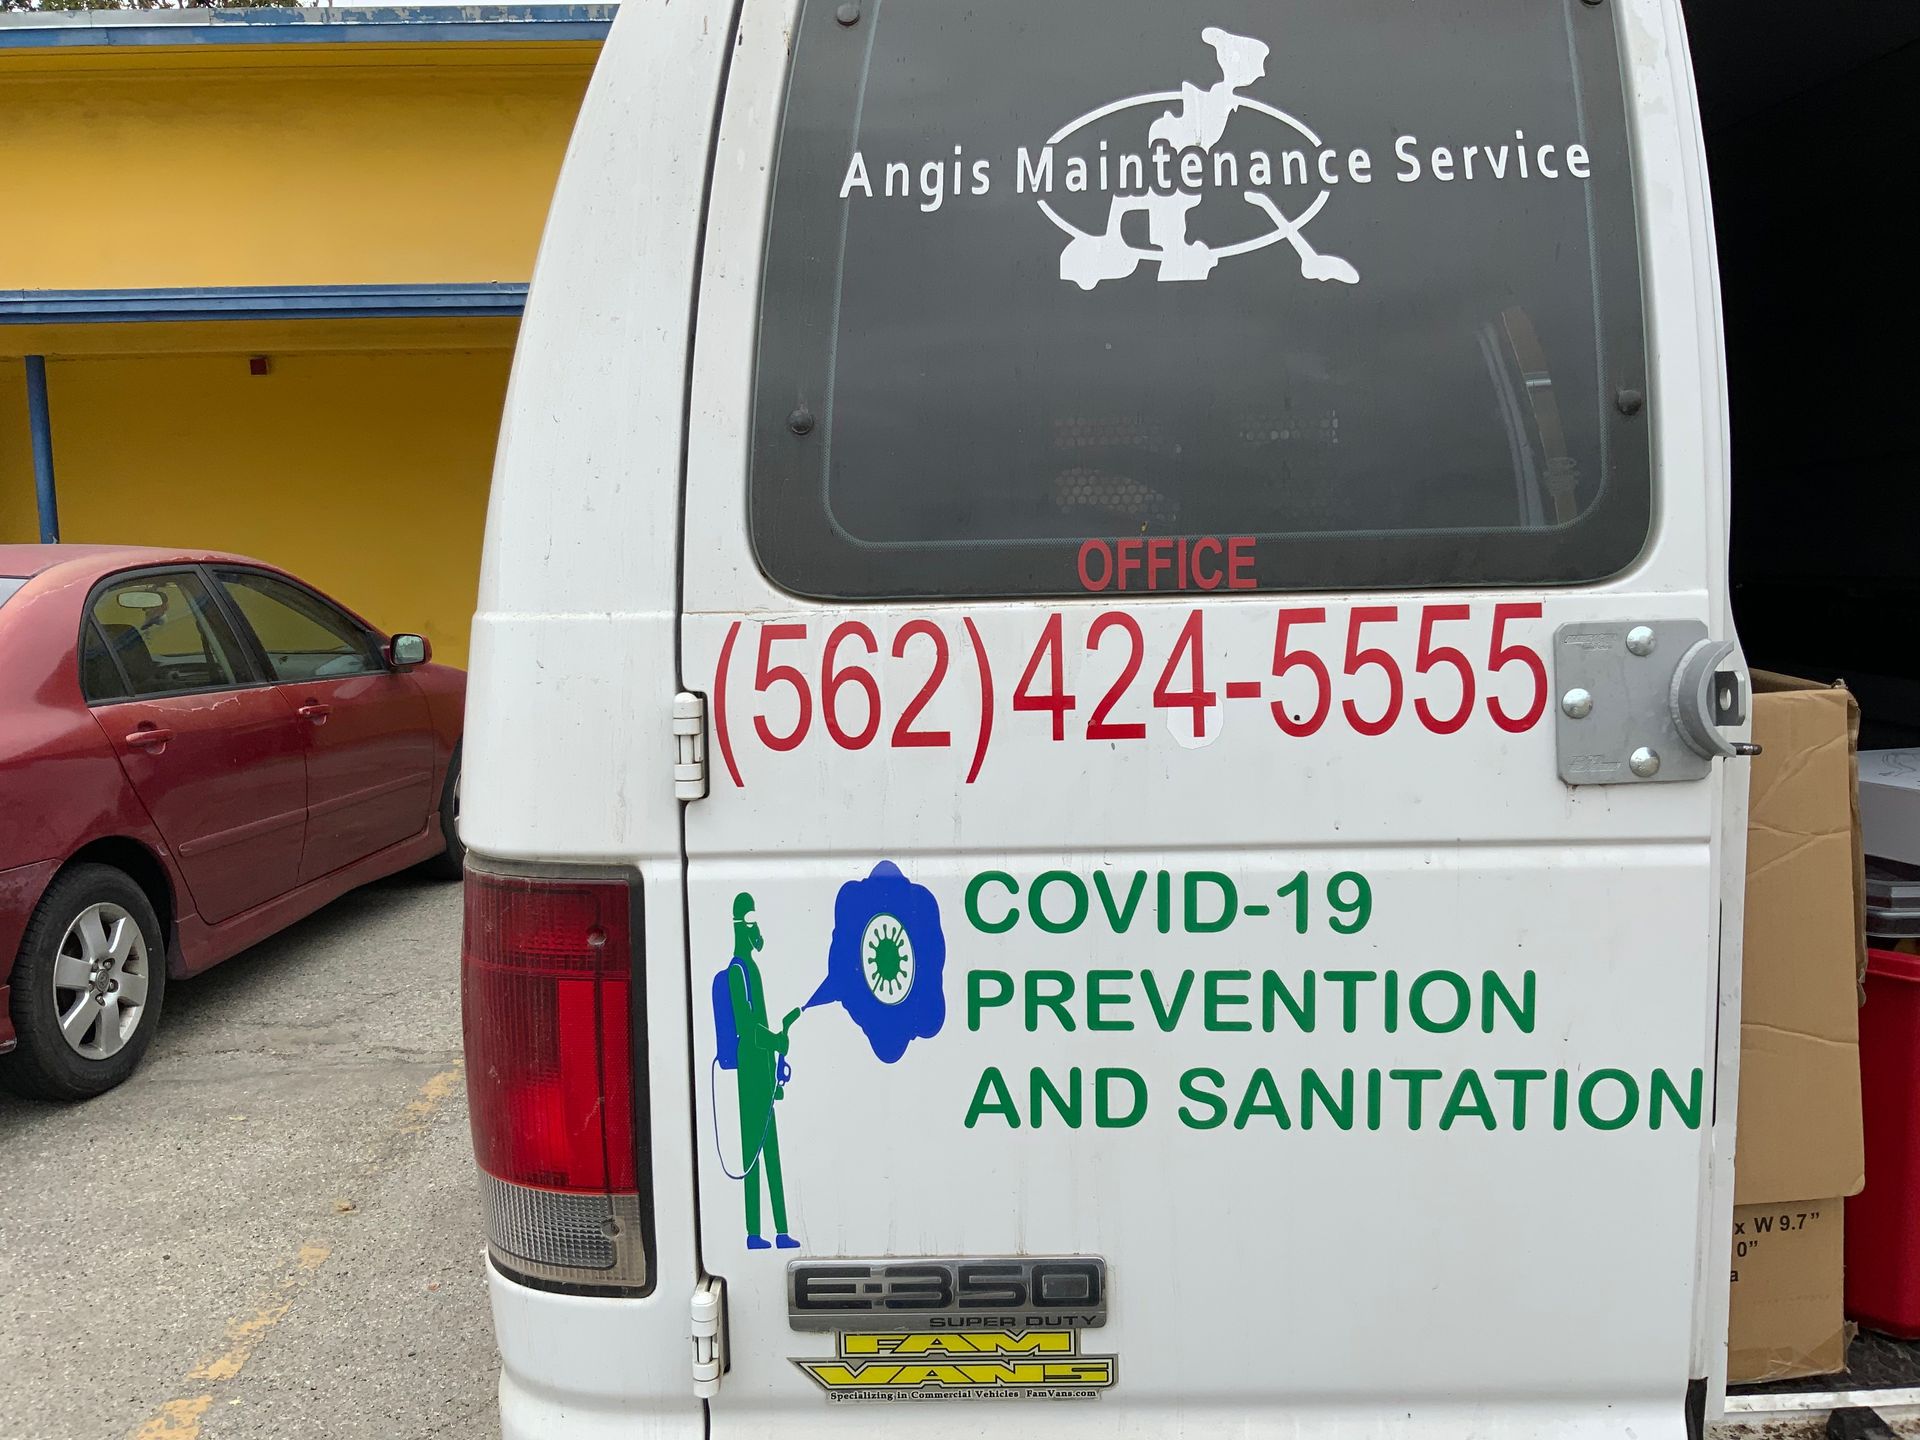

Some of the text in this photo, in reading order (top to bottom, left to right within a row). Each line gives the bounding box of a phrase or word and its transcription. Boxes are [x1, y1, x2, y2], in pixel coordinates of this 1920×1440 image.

[839, 129, 1591, 213] Angis Maintenance Service
[1078, 537, 1257, 592] OFFICE
[713, 602, 1549, 788] (562)424-5555
[963, 870, 1373, 936] COVID-19
[966, 968, 1537, 1035] PREVENTION
[963, 1066, 1704, 1132] AND SANITATION
[795, 1263, 1101, 1310] E-350
[840, 1331, 1076, 1357] FAM
[929, 1314, 1098, 1328] SUPER DUTY
[801, 1359, 1113, 1387] VANS
[830, 1388, 1097, 1401] Specializing in Commercial Vehicles FamVans.com
